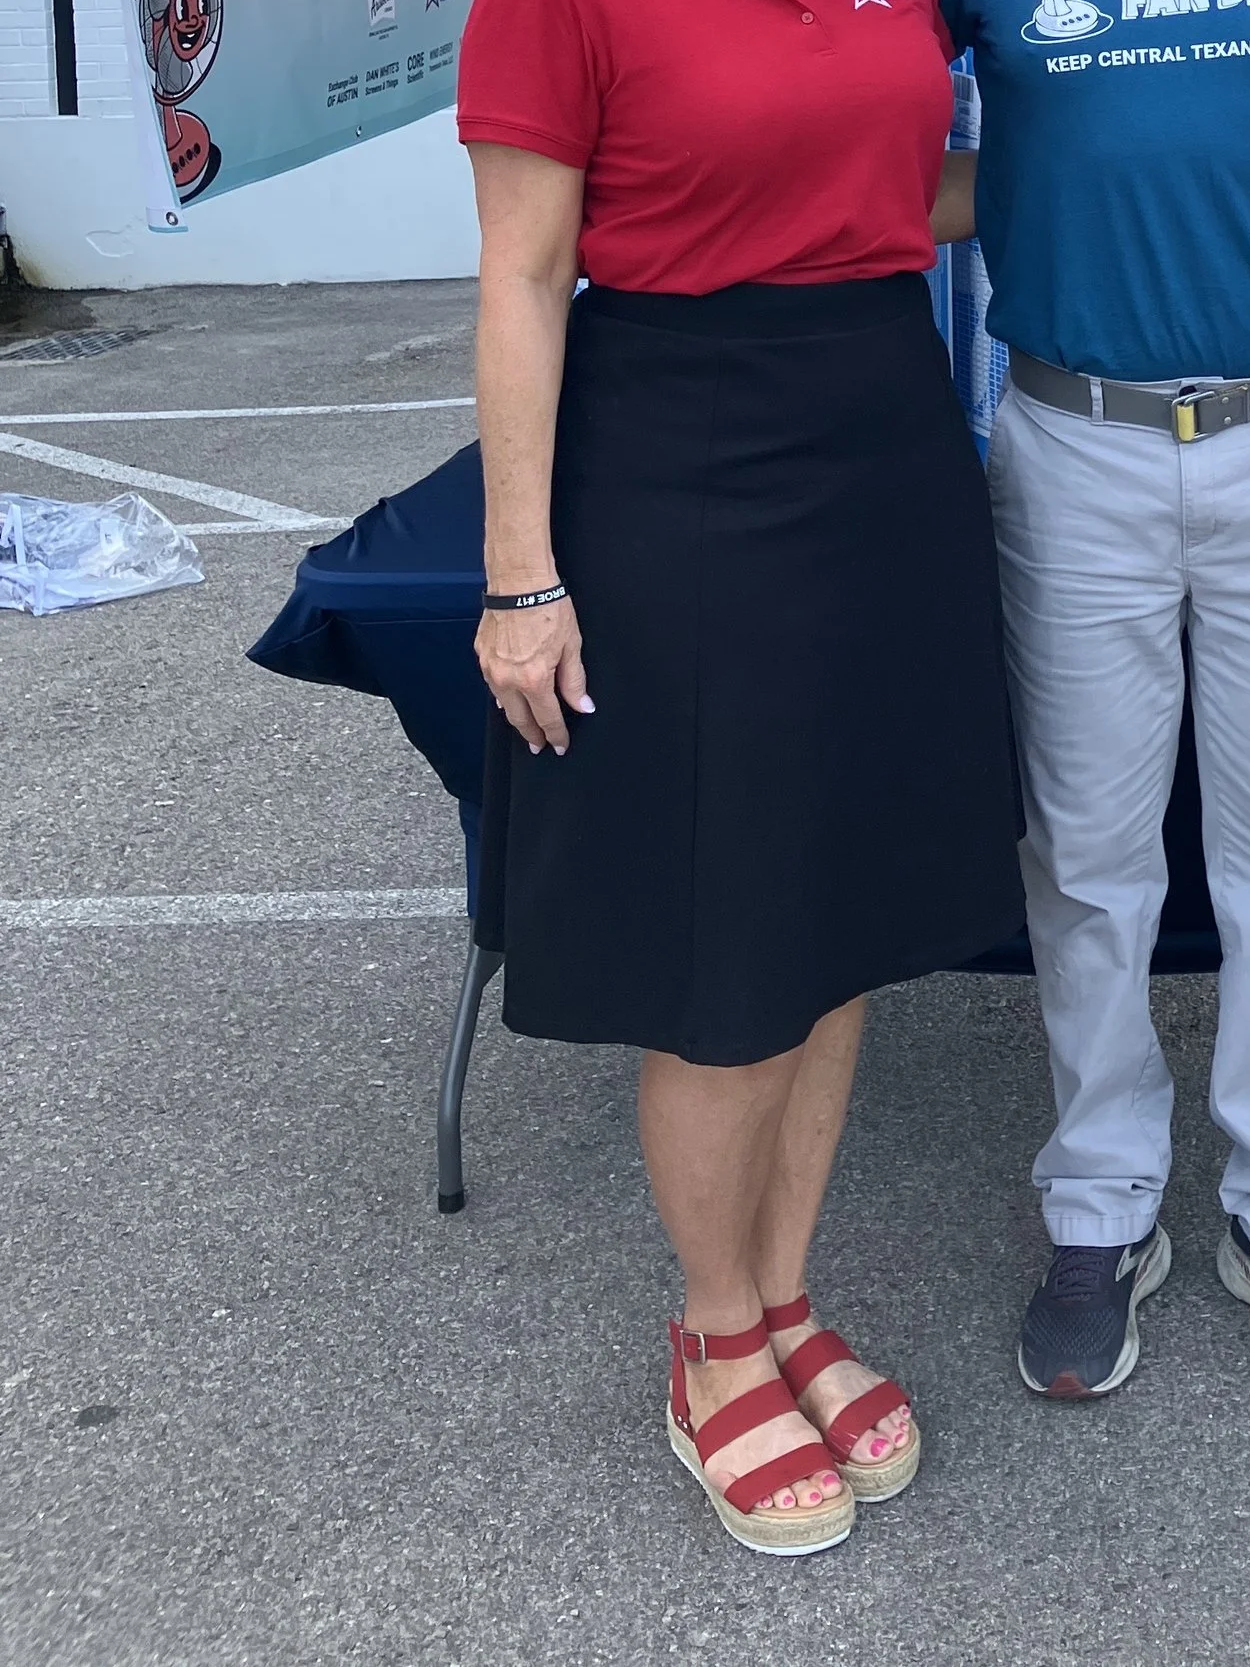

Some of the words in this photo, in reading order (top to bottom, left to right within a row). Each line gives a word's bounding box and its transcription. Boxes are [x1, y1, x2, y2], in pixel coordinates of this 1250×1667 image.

[1046, 54, 1093, 73] KEEP
[1098, 45, 1186, 68] CENTRAL
[516, 596, 535, 607] #17
